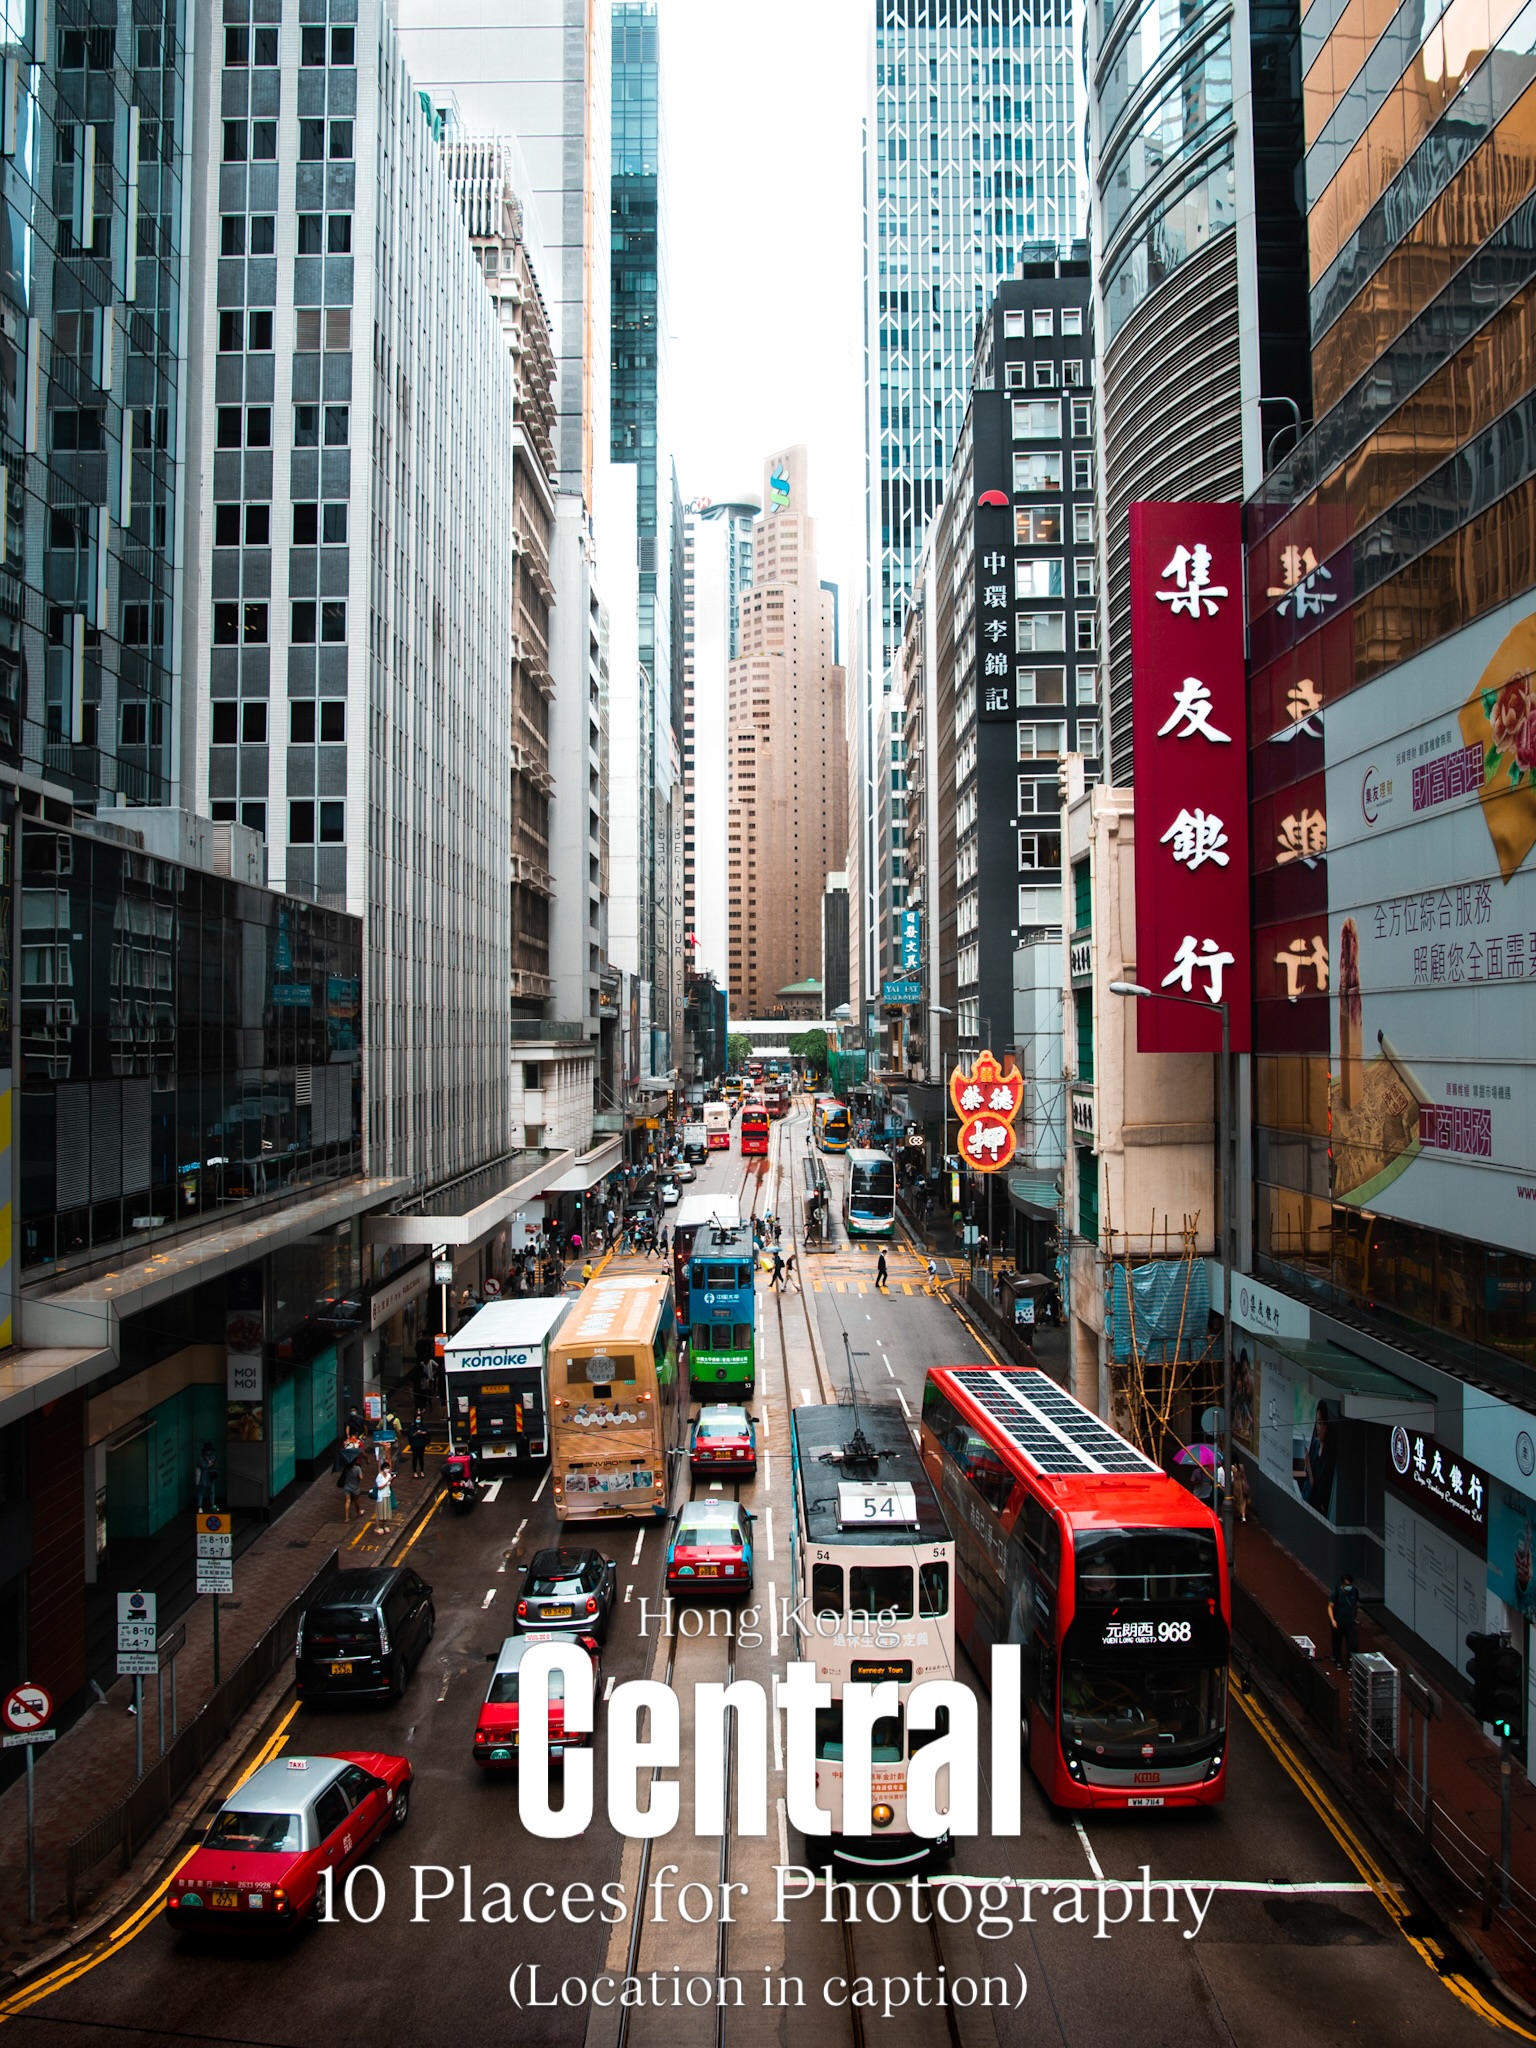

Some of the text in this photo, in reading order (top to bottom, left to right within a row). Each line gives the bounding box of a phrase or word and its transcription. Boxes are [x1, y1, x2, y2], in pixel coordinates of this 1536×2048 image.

[983, 551, 1009, 712] 中環李錦記
[1155, 543, 1235, 1003] 集友銀行
[1413, 744, 1485, 810] 財富管理
[1374, 879, 1492, 939] 全方位綜合服務
[674, 920, 682, 957] FUR
[904, 912, 918, 968] 日發文具
[675, 970, 683, 1035] STORE
[967, 1120, 1007, 1161] 押
[1420, 1108, 1491, 1157] 工商服務
[235, 1368, 256, 1377] MOI
[235, 1379, 256, 1388] MOI
[1413, 1436, 1483, 1509] 集友銀行
[863, 1497, 895, 1518] 54
[209, 1536, 229, 1544] 8-10
[210, 1548, 224, 1556] 5-7
[816, 1548, 946, 1560] 54 54
[133, 1627, 154, 1635] 8-10
[133, 1639, 149, 1647] 4-7
[1105, 1621, 1191, 1642] 元朗西 968
[858, 1666, 885, 1675] Kennedy
